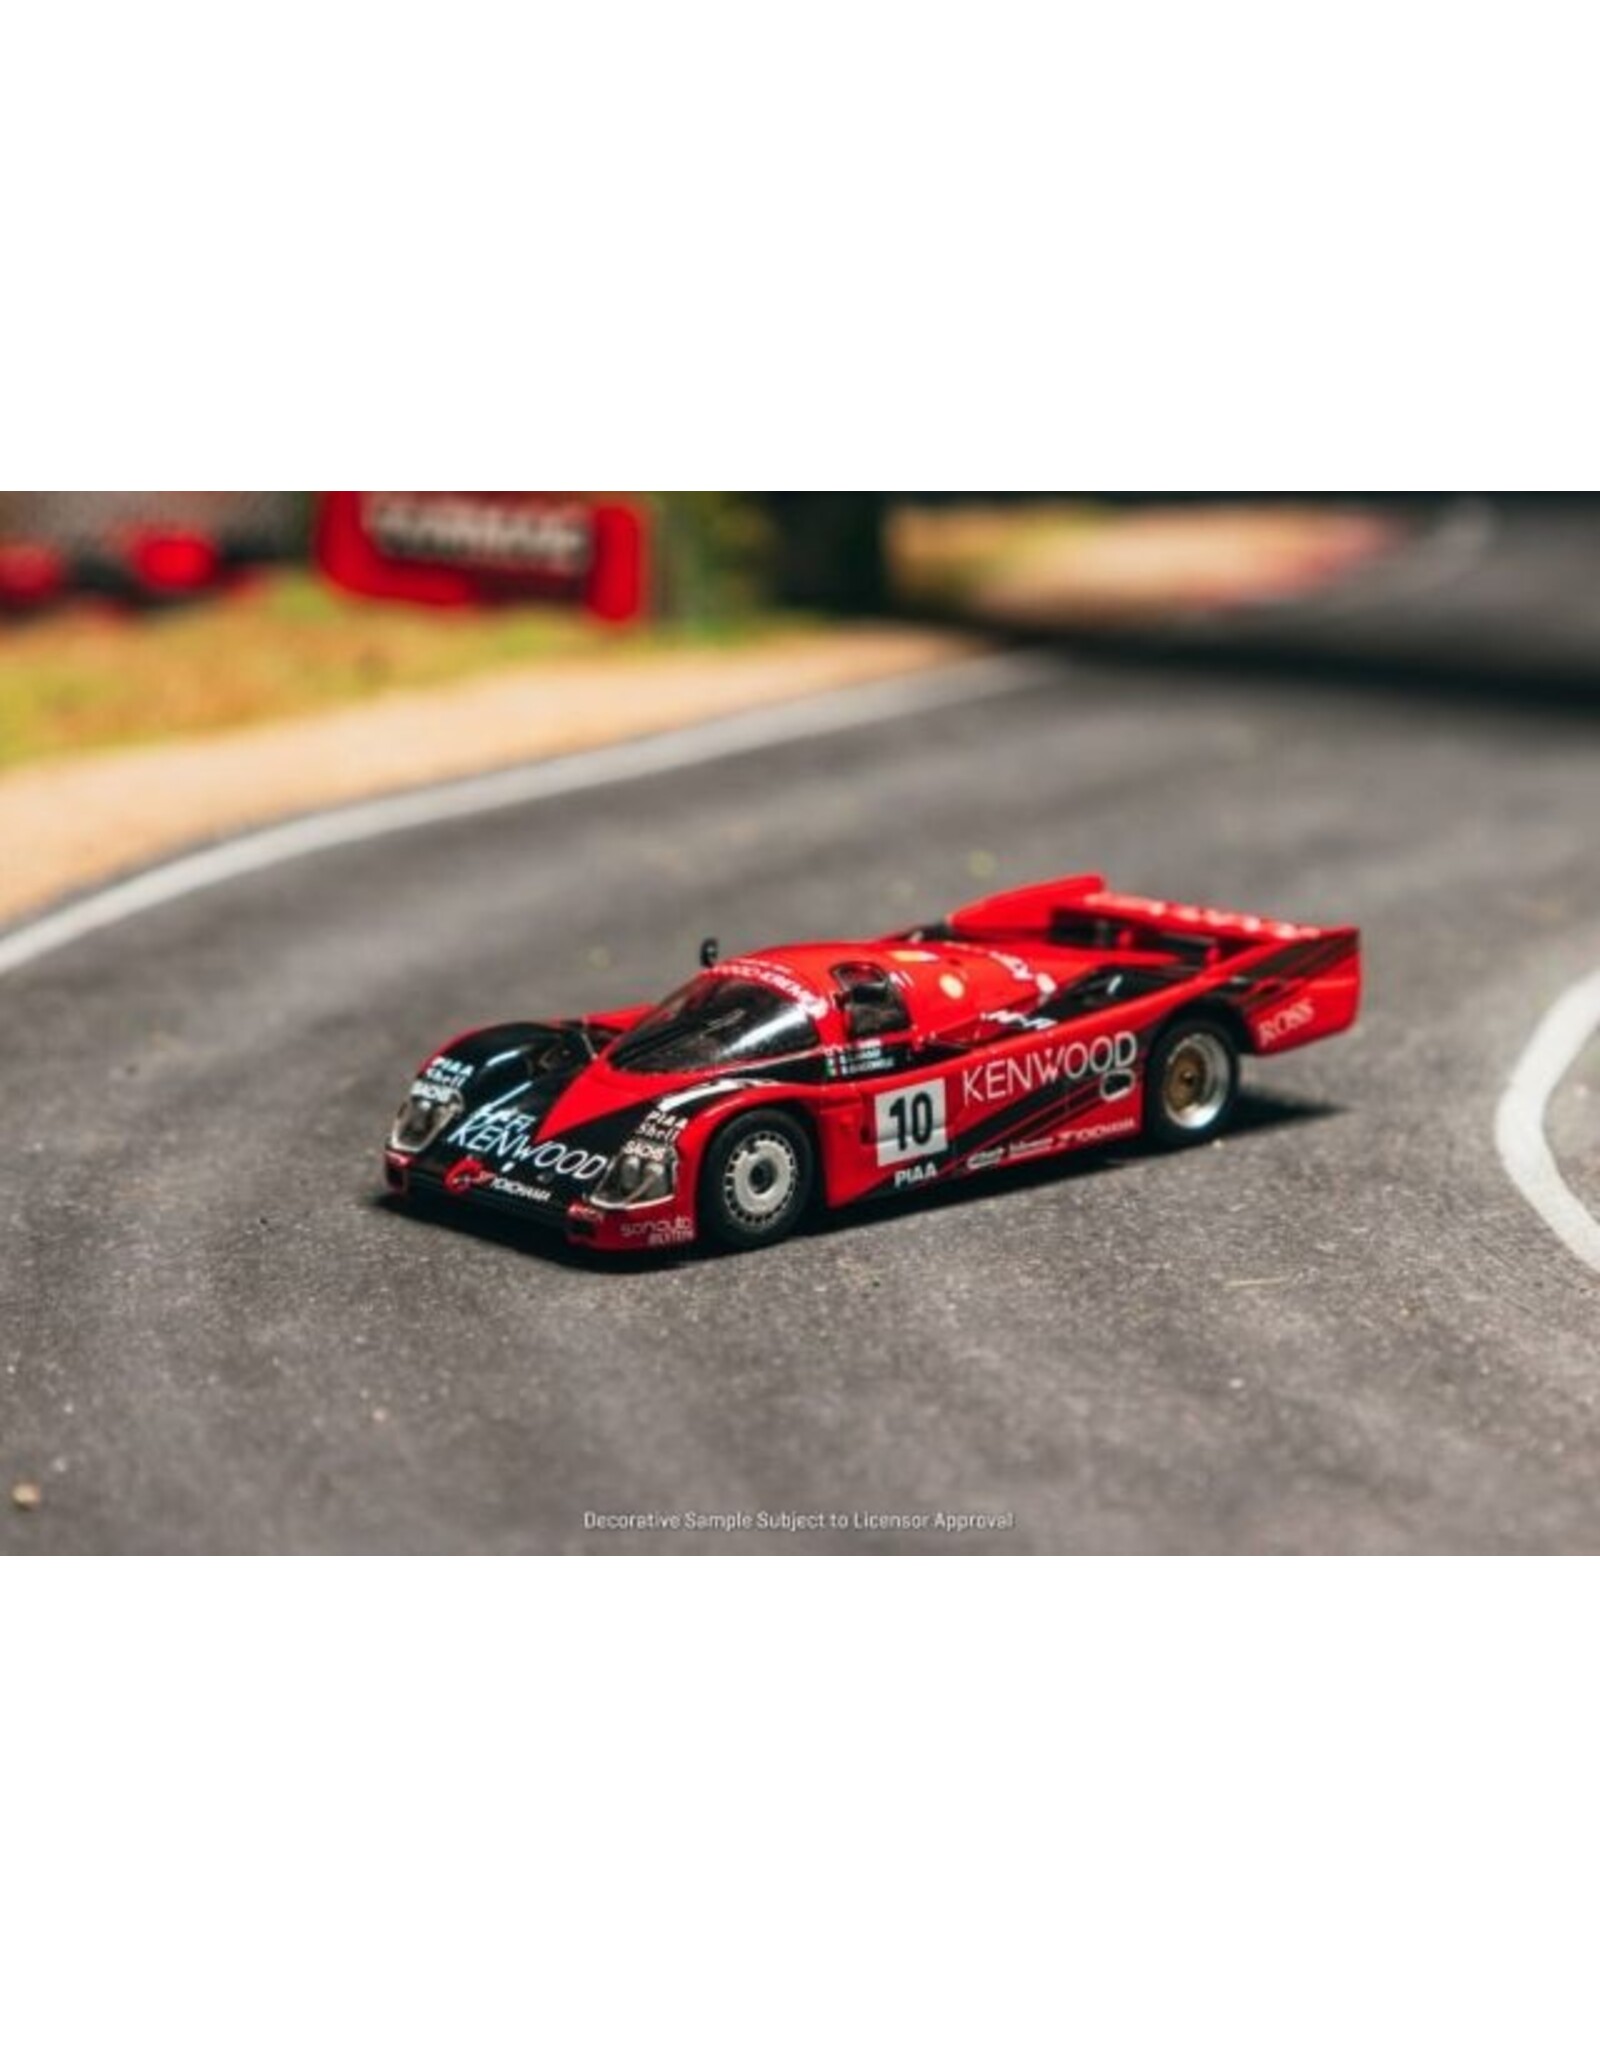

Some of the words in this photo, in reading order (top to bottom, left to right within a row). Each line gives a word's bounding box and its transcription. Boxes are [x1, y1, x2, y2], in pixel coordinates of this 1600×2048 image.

[962, 1031, 1136, 1105] KENWOOD
[447, 1112, 608, 1180] KENWOOD
[645, 1110, 689, 1130] PIAA
[889, 1091, 933, 1151] 10
[894, 1162, 938, 1188] PIAA
